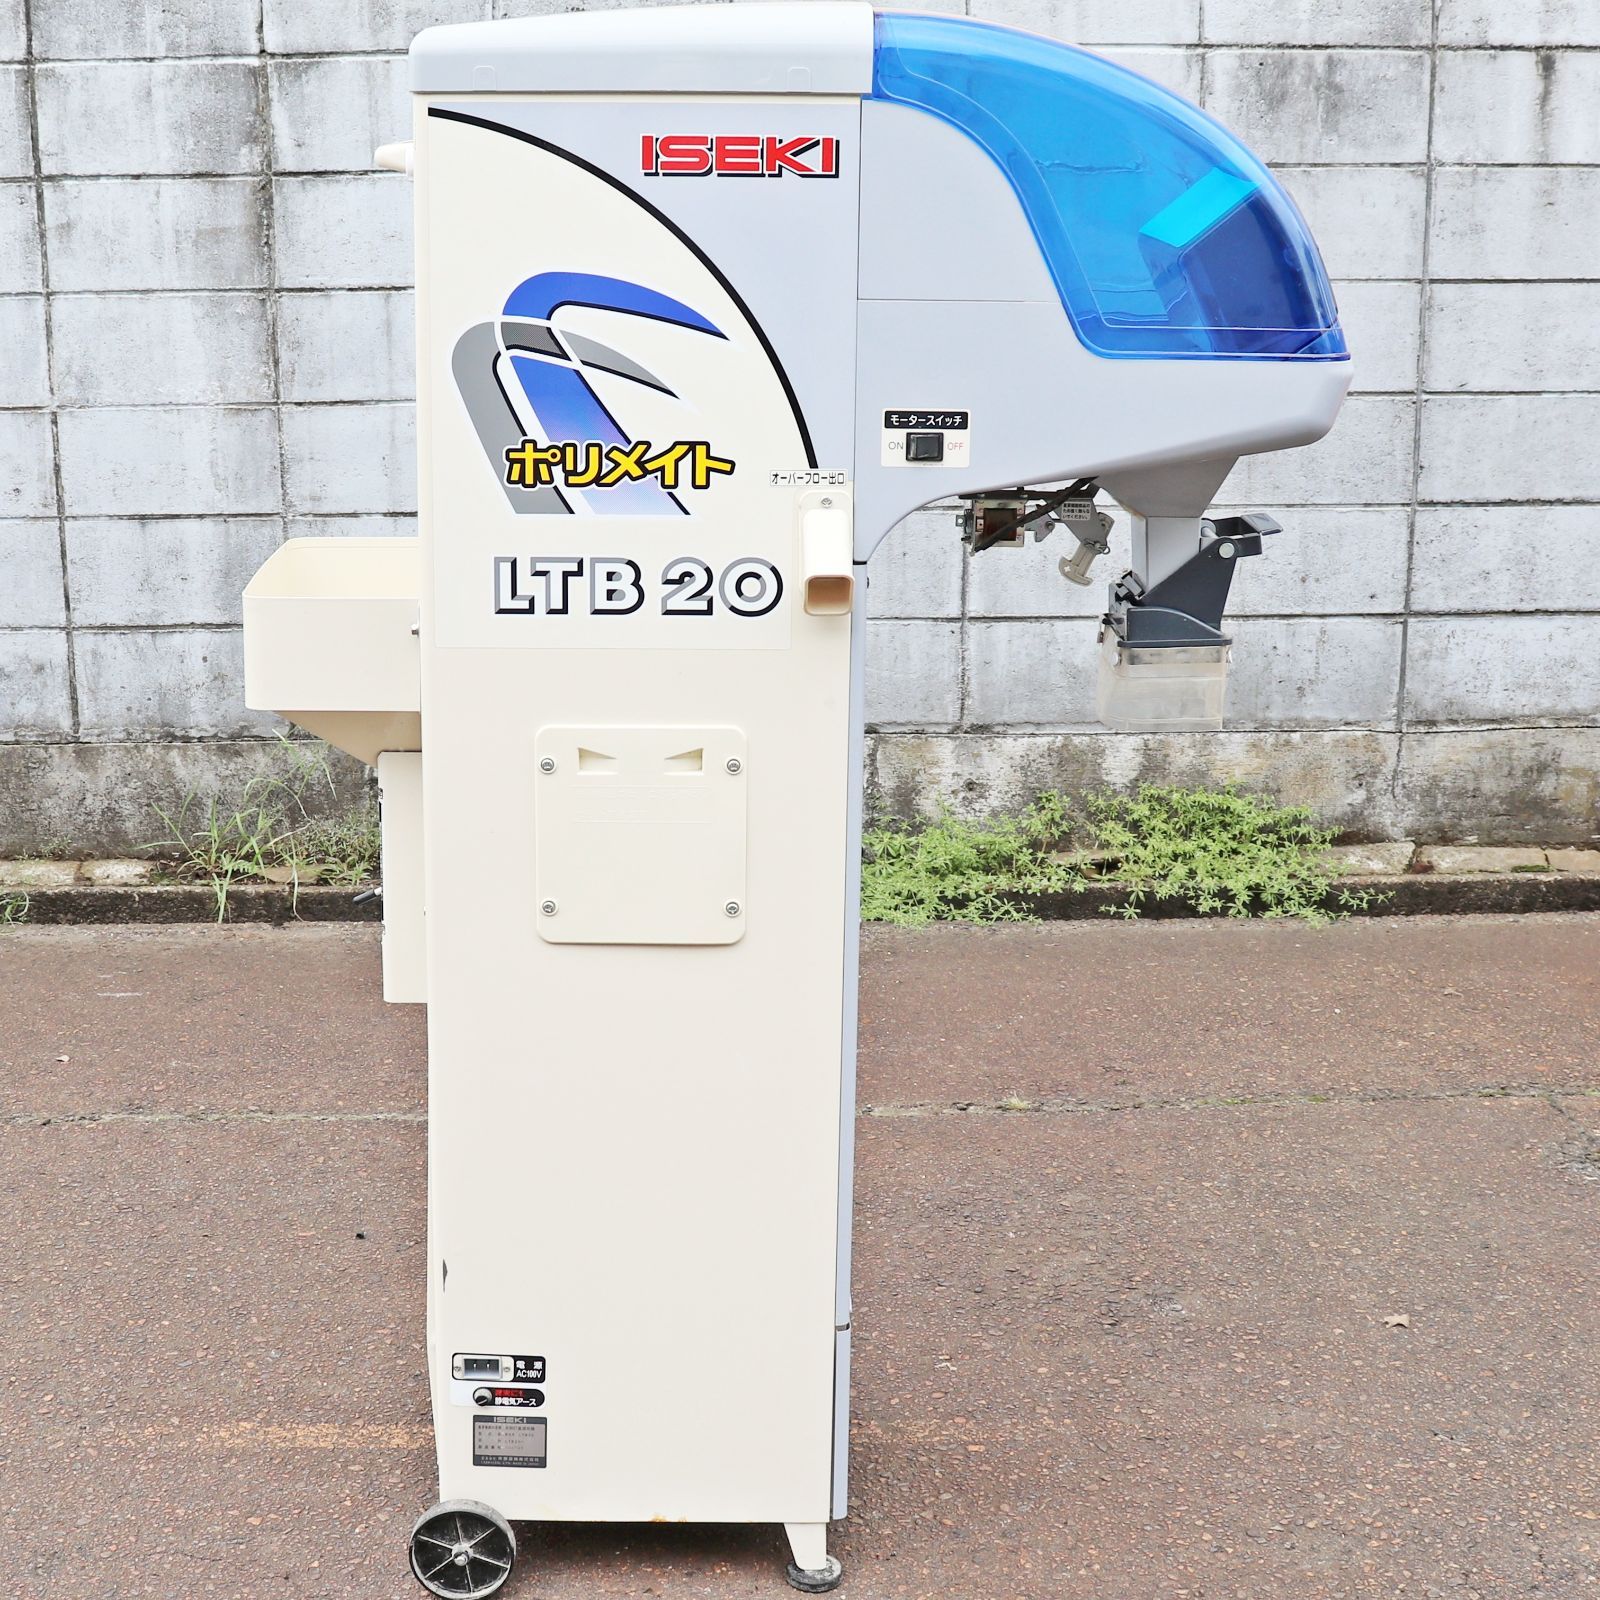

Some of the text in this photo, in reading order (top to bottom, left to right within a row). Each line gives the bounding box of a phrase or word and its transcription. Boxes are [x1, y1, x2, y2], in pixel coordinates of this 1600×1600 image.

[640, 133, 840, 178] ISEKI
[890, 414, 963, 426] モータースイッチ
[888, 441, 964, 450] ON OFF
[505, 439, 736, 490] ポリメイト
[772, 471, 845, 485] オーバーフロー出口
[494, 557, 783, 617] LTB 20
[516, 1370, 543, 1378] AC100V
